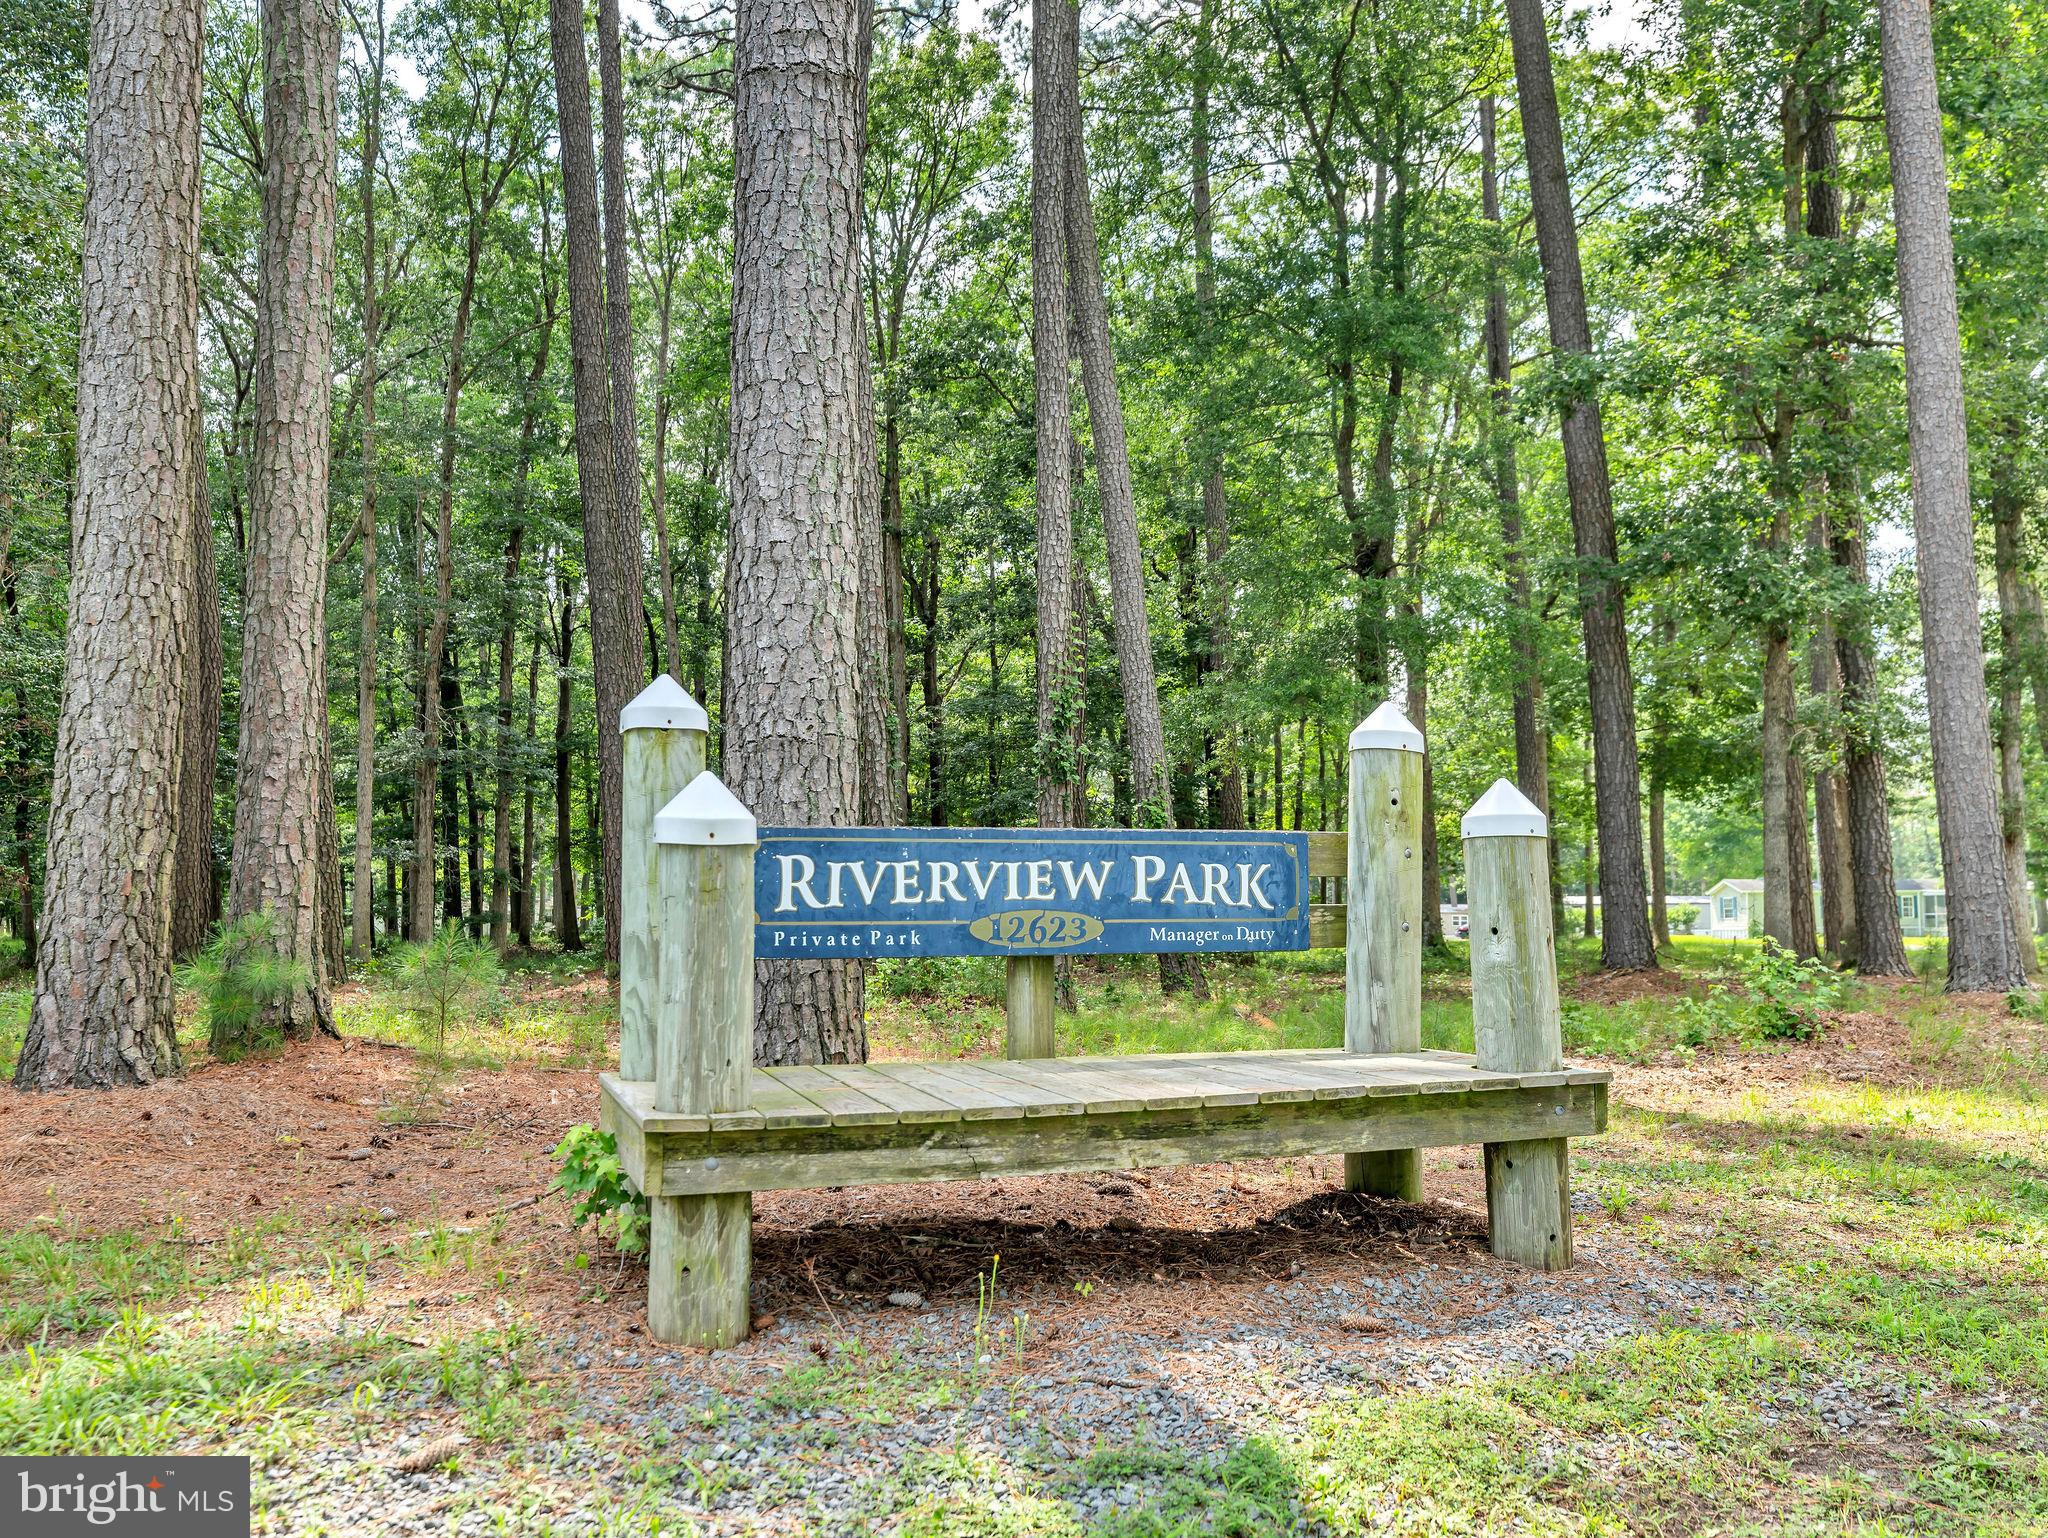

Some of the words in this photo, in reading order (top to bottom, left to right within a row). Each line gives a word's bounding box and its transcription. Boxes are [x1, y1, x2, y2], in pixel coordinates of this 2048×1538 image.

[774, 854, 1115, 912] RIVERVIEW
[1131, 855, 1275, 911] PARK
[773, 931, 861, 947] Private
[870, 930, 921, 946] Park
[991, 914, 1088, 945] 12623
[1150, 927, 1220, 947] Manager
[1221, 933, 1234, 941] on
[1236, 926, 1276, 946] Duty
